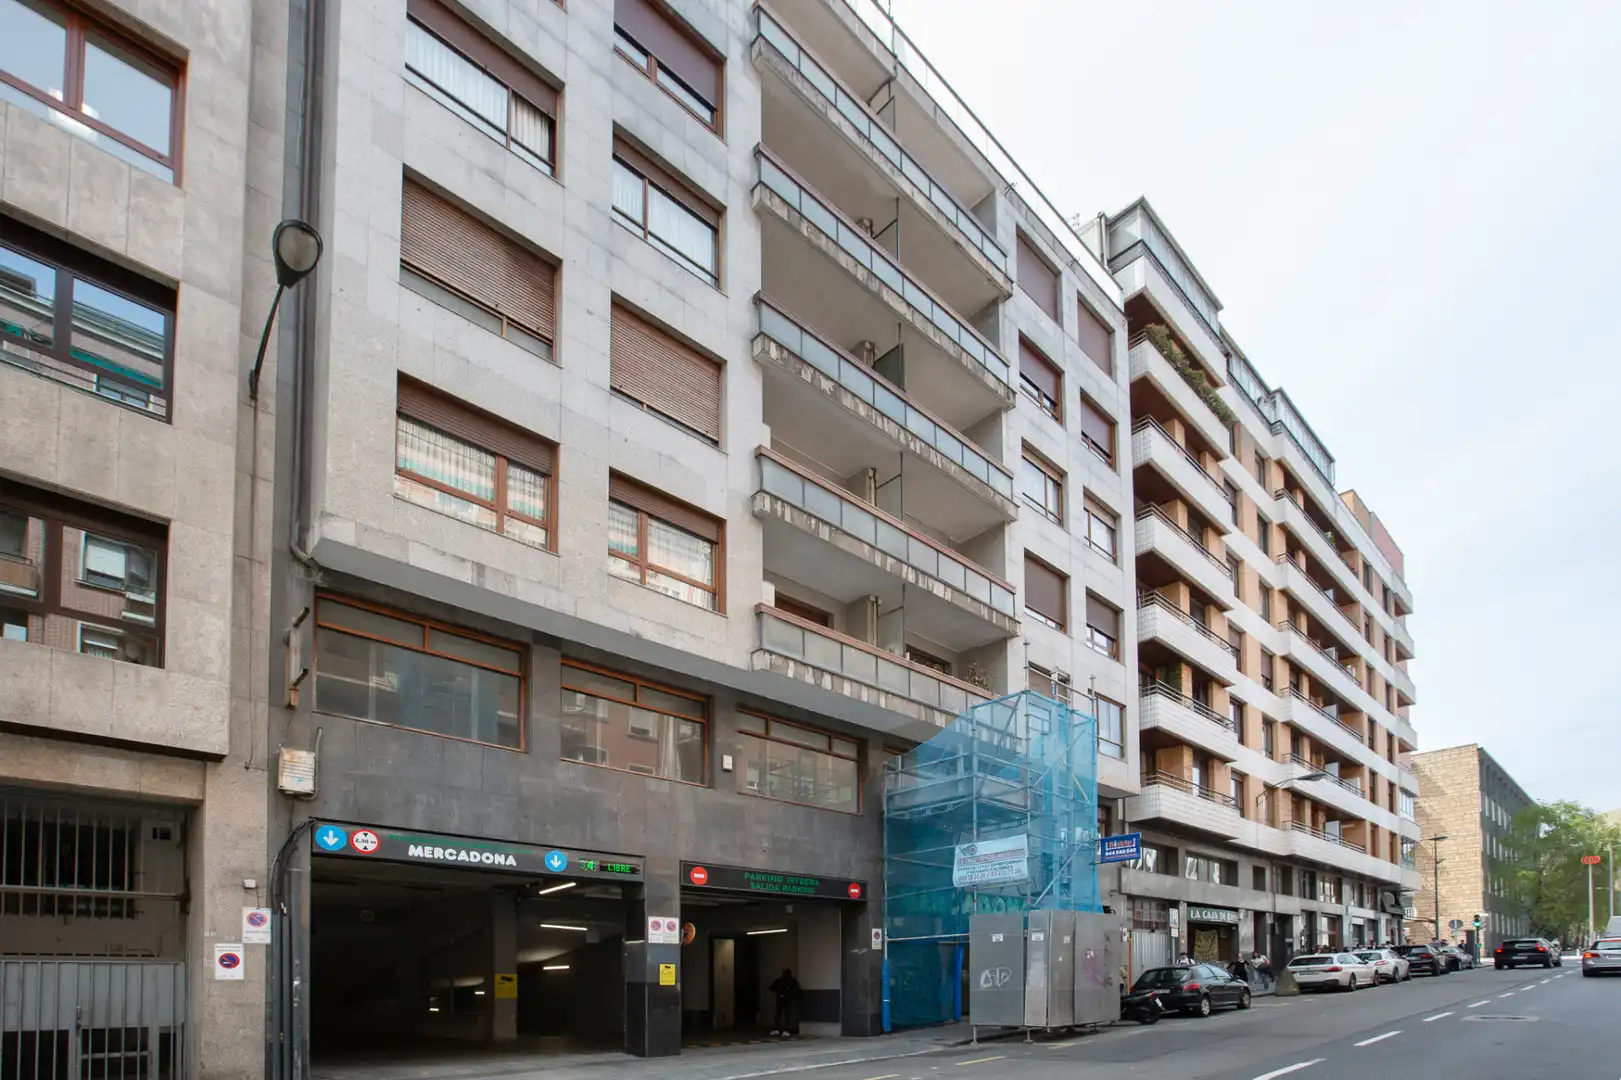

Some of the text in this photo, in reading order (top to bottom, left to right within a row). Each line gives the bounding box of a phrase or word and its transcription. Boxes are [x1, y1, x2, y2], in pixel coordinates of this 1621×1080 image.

[408, 844, 517, 866] MERCADONA
[607, 863, 631, 873] LIBRE
[744, 872, 783, 883] PARKING
[750, 881, 781, 892] SALIDA
[1190, 909, 1201, 919] LA
